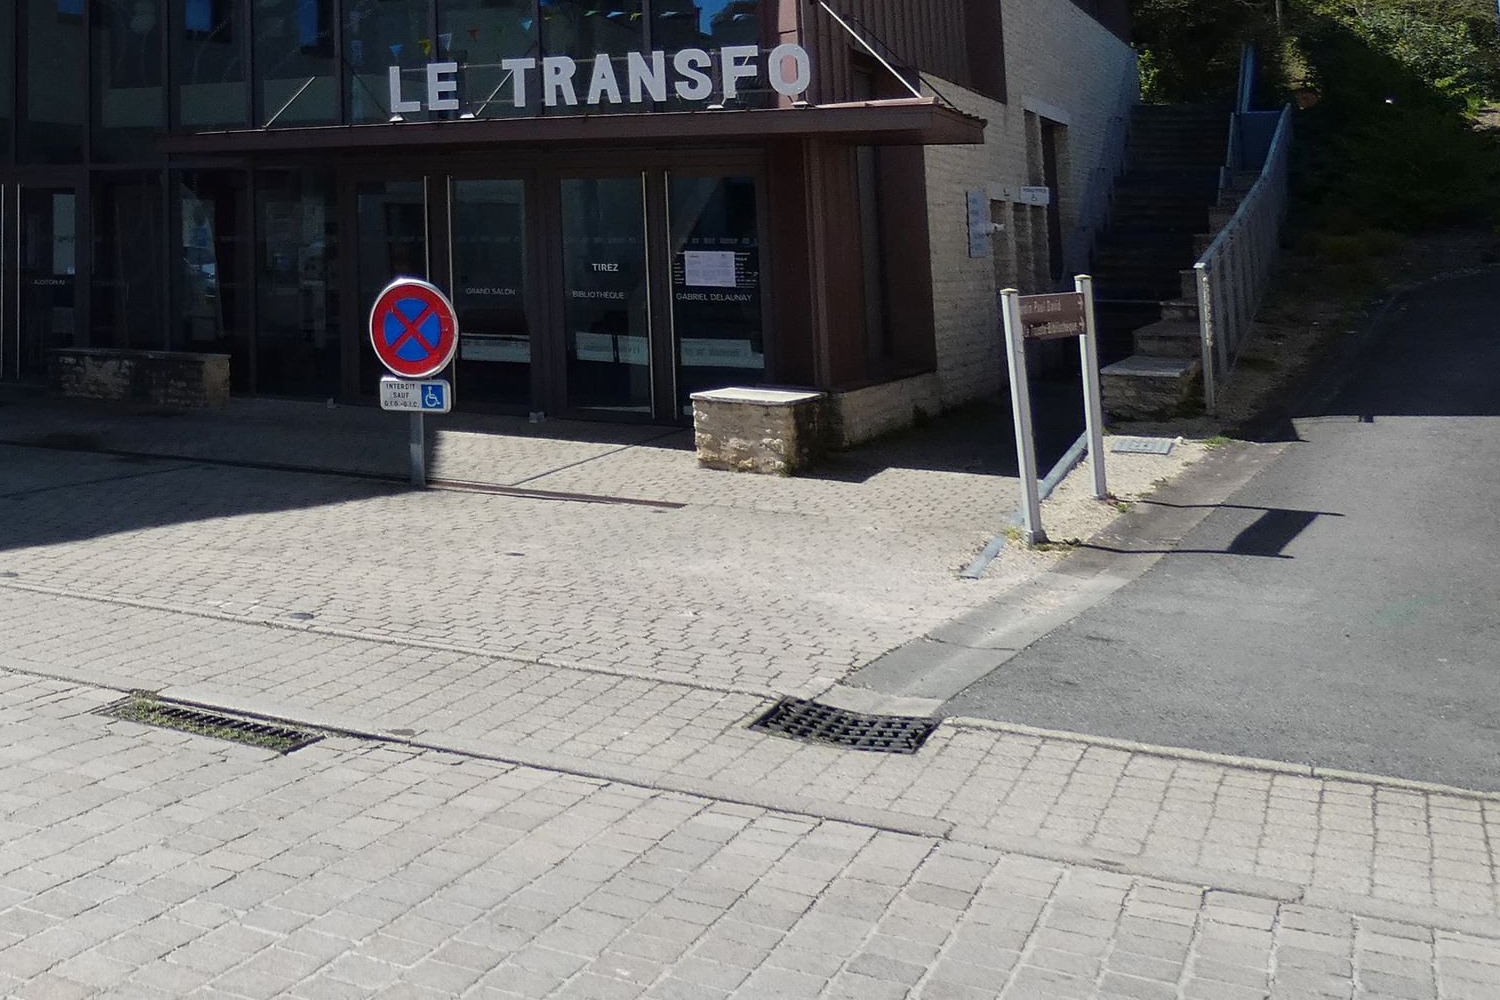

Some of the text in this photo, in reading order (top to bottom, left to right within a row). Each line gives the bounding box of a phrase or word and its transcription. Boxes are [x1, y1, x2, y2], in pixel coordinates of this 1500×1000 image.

[388, 42, 811, 113] LE TRANSFO
[591, 263, 619, 272] TIREZ
[465, 287, 516, 296] GRAND SALON
[675, 292, 753, 302] GABRIEL DELAUNAY
